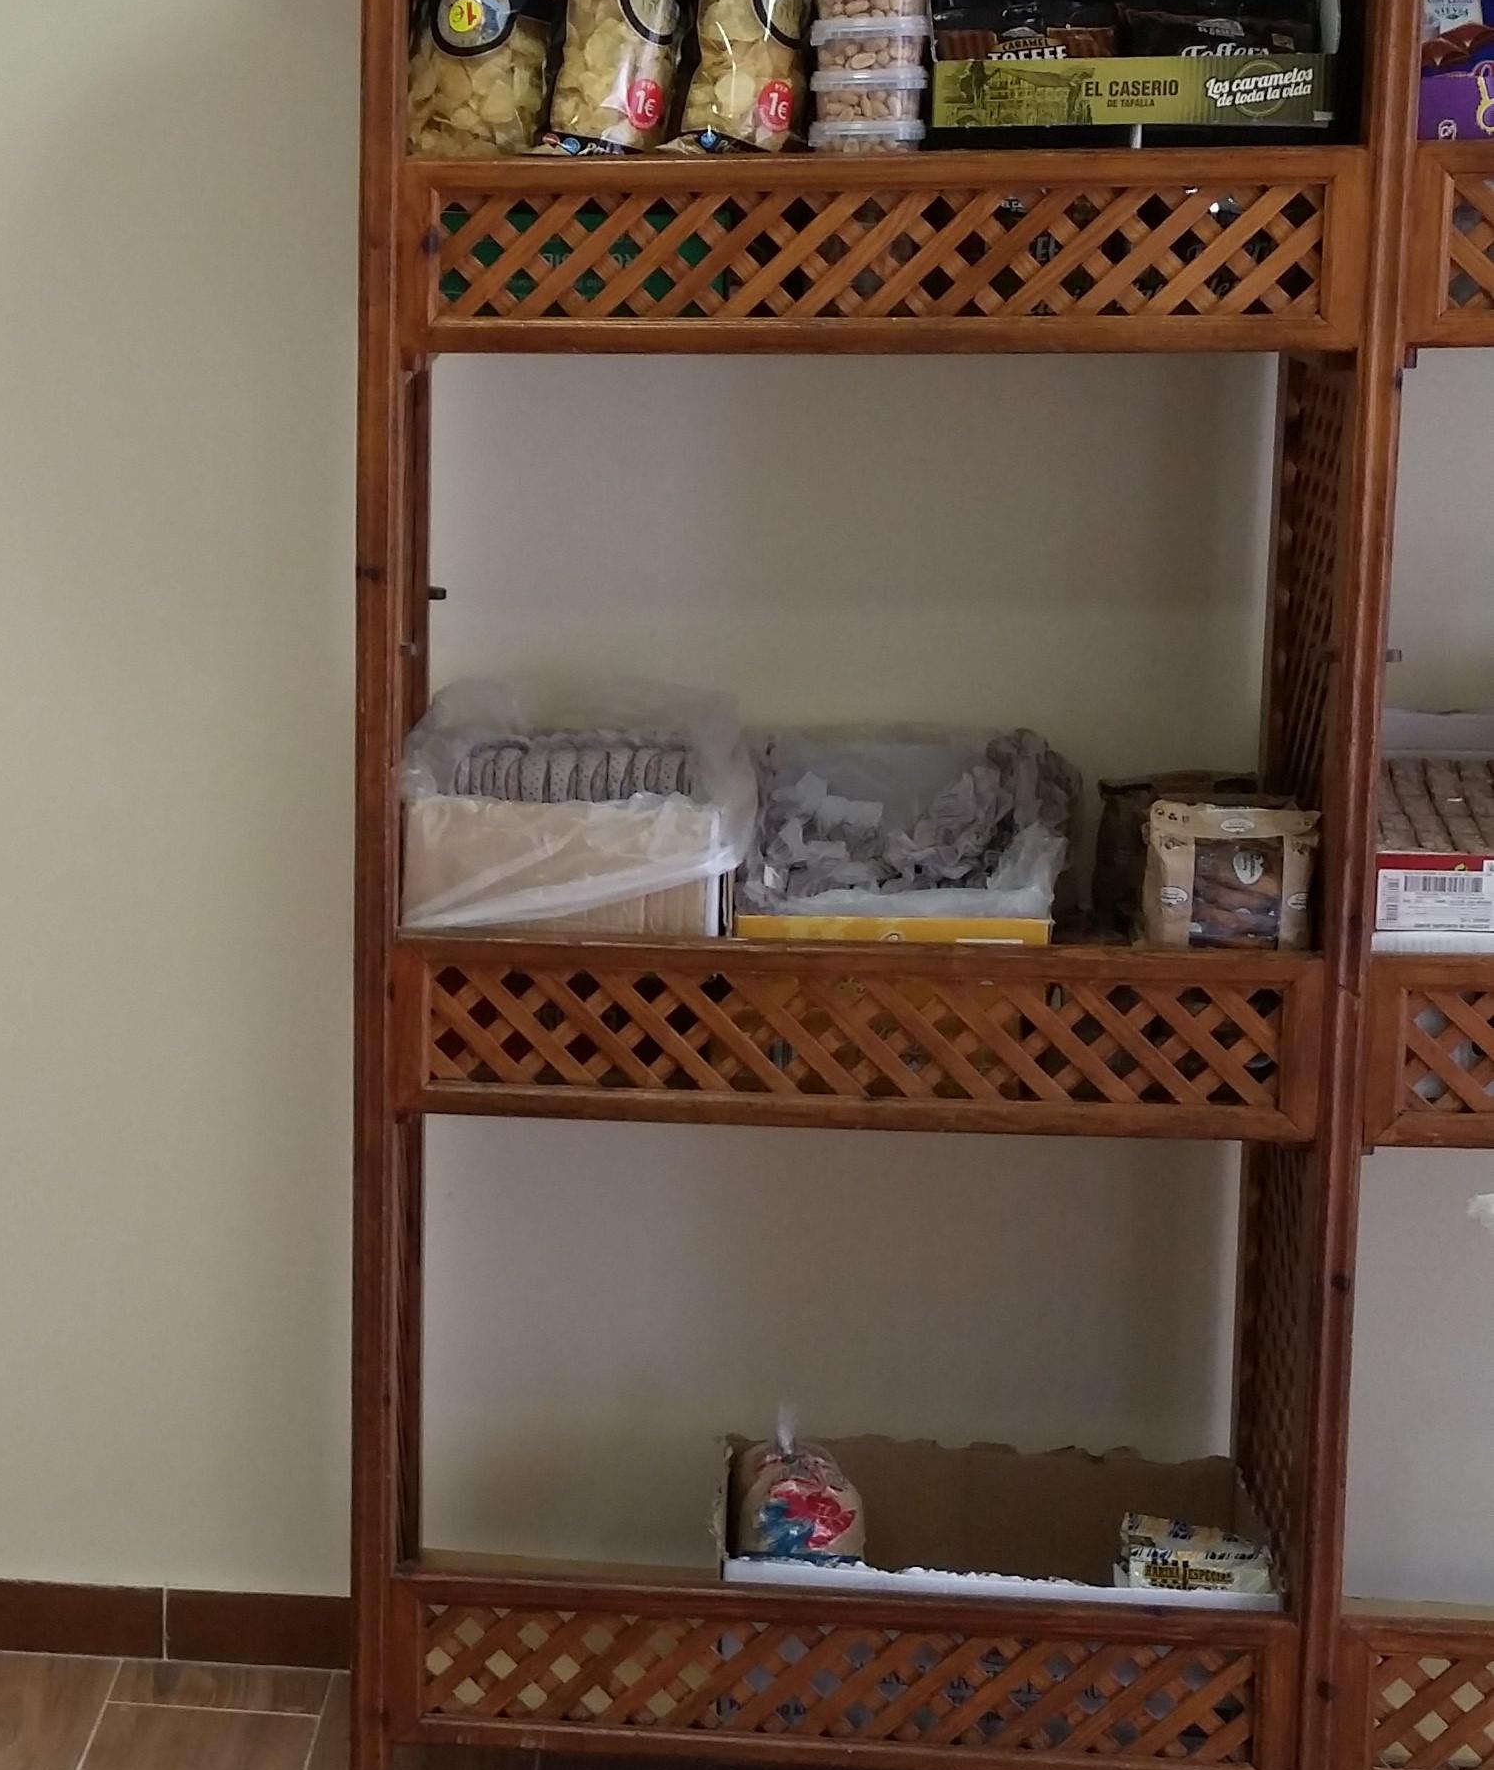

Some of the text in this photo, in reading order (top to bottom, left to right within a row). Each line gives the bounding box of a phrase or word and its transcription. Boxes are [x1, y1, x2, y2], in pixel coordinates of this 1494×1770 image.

[1084, 80, 1178, 97] EL CASERIO
[1206, 68, 1313, 97] Los caramelos
[1107, 98, 1155, 107] DE TAFALLA
[1217, 82, 1312, 108] de toda la vida
